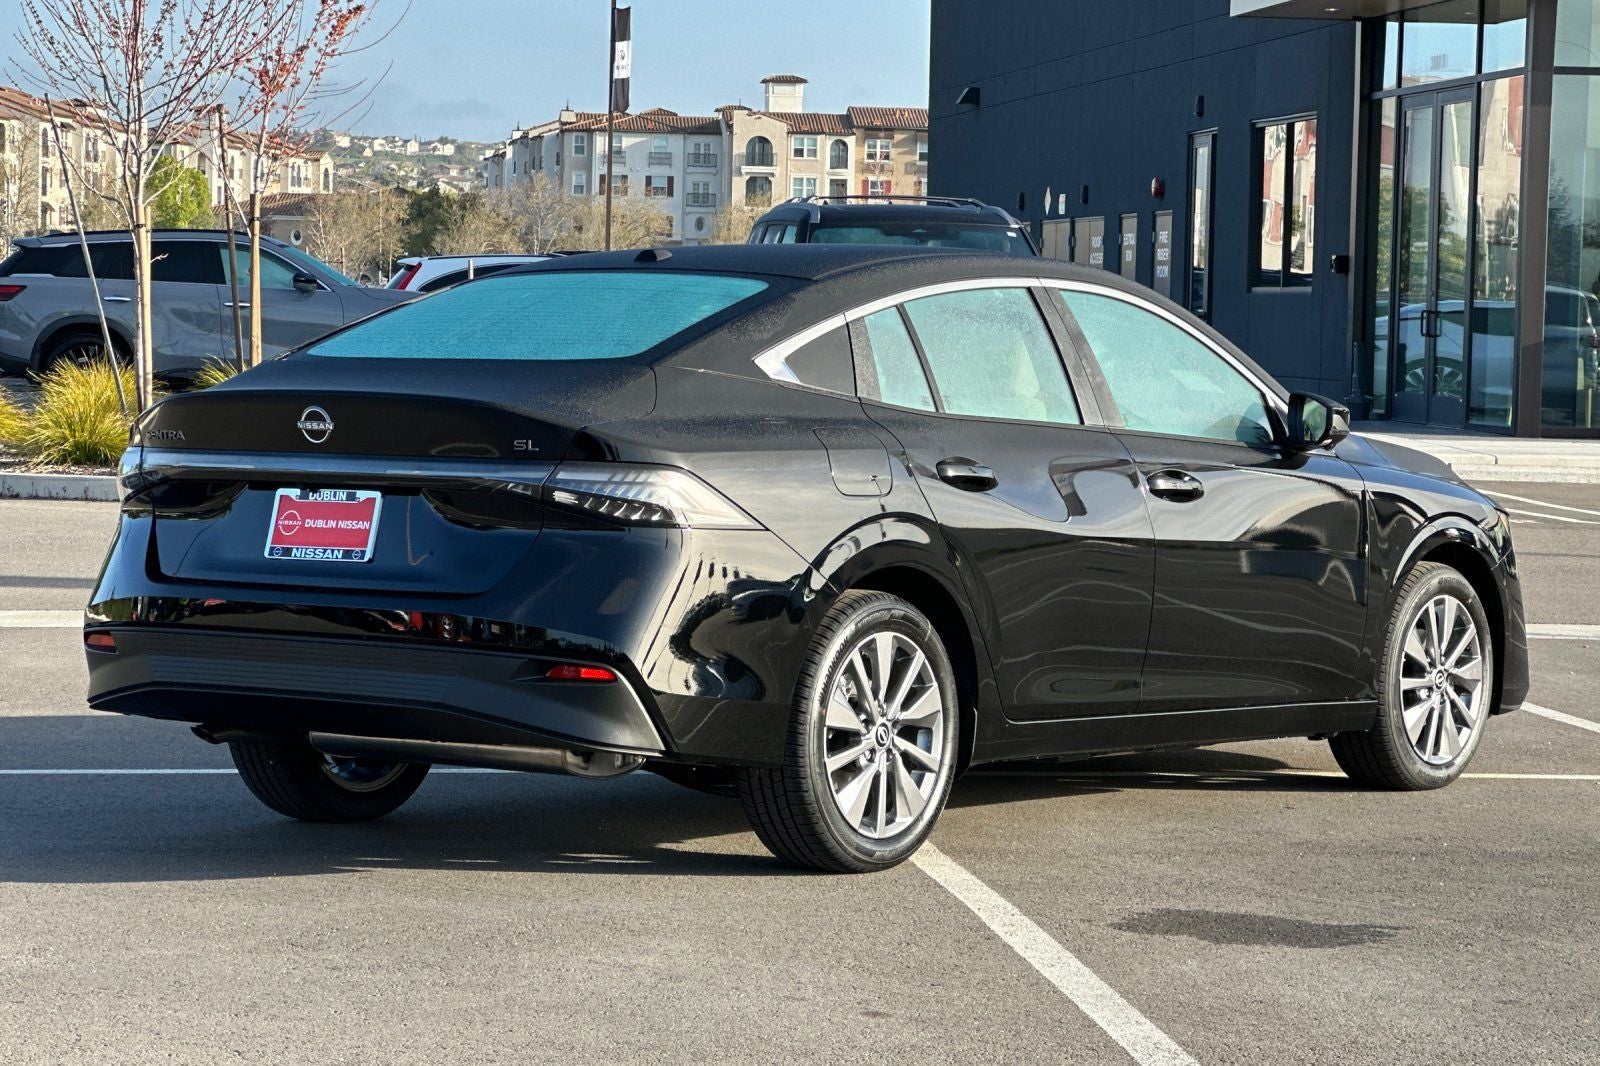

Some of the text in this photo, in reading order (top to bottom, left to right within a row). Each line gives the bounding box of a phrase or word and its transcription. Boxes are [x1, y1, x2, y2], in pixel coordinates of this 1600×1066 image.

[1159, 231, 1169, 243] FIRE
[297, 421, 335, 430] NISSAN
[146, 430, 186, 441] SENTRA
[513, 439, 540, 451] SL
[309, 491, 347, 501] DUBLIN
[304, 519, 371, 530] DUBLIN NISSAN
[291, 548, 344, 559] NISSAN
